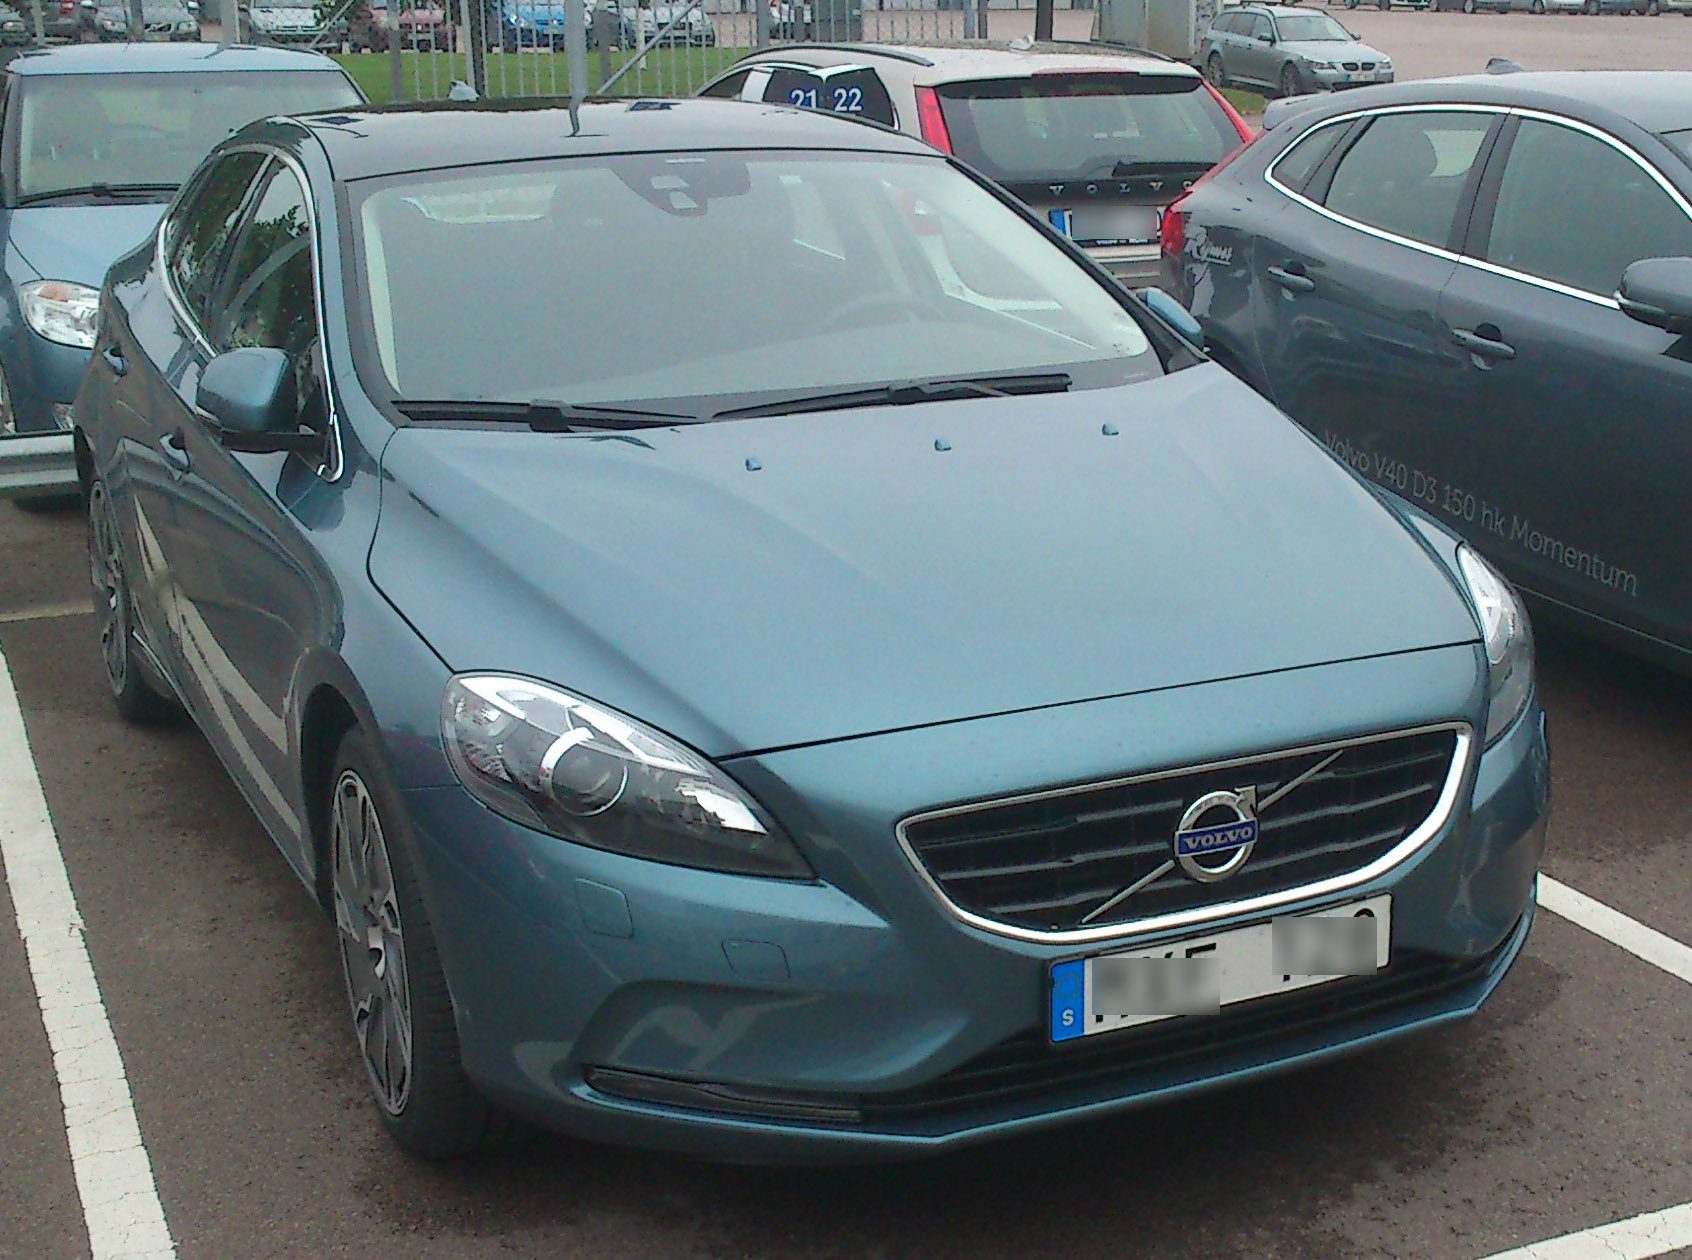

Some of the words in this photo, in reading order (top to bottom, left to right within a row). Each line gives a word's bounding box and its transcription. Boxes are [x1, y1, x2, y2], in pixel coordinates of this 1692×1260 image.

[791, 88, 818, 108] 21
[833, 87, 863, 112] 22
[1375, 453, 1408, 489] V40
[1412, 470, 1438, 503] D3
[1442, 484, 1475, 521] 150
[1481, 501, 1505, 536] hk
[1509, 515, 1637, 597] Momentum
[1183, 826, 1254, 849] VOLVO
[1061, 1008, 1074, 1026] S
